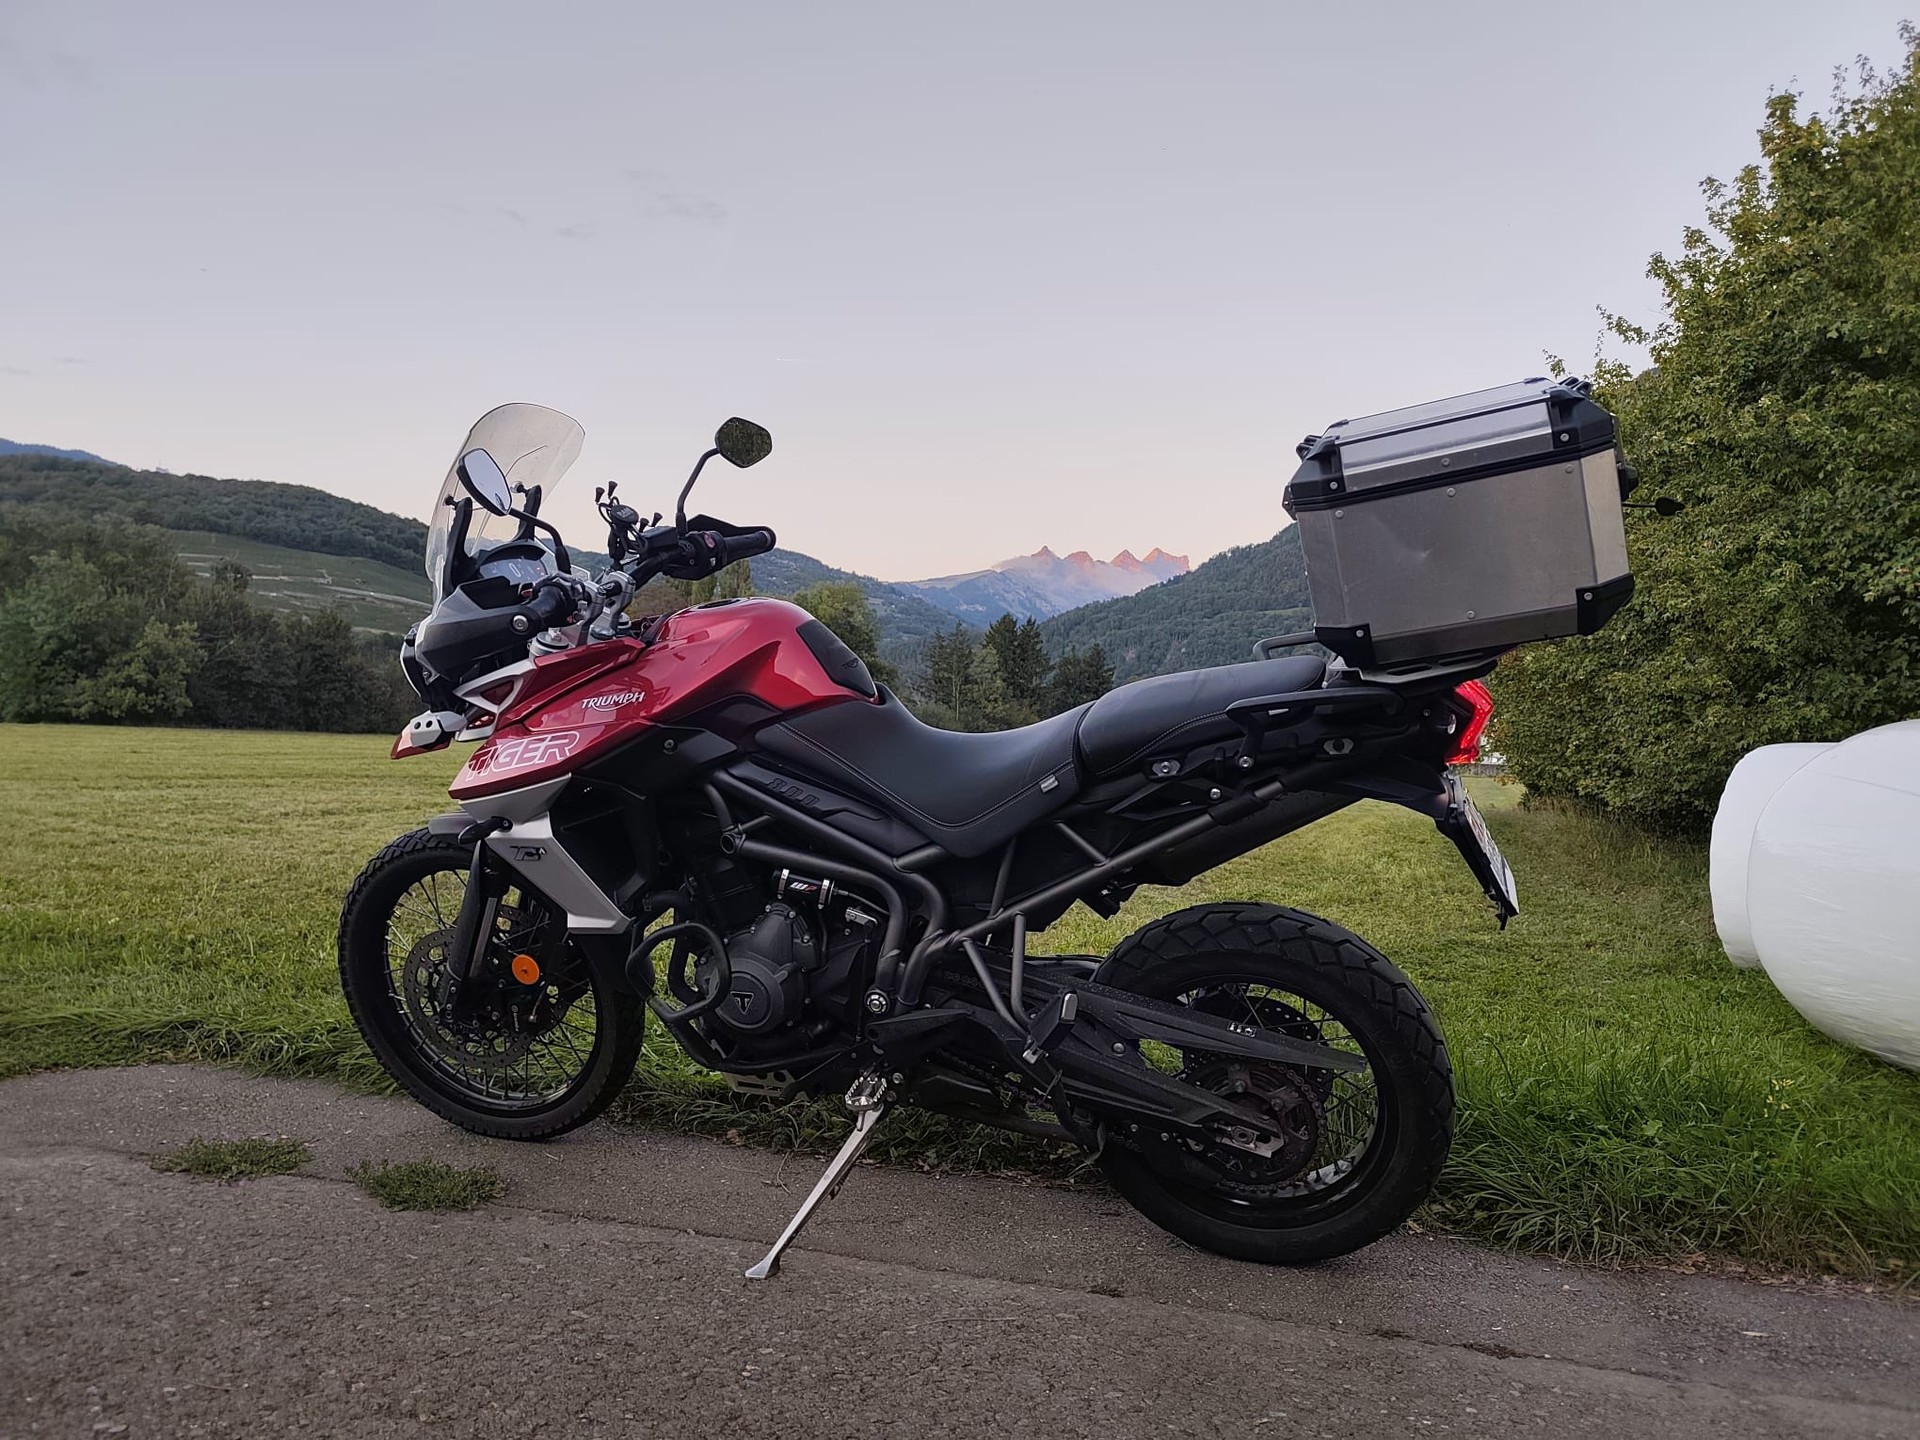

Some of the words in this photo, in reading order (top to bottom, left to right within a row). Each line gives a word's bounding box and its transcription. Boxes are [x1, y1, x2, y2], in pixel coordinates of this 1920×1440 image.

[581, 691, 646, 711] TRIUMPH
[466, 731, 580, 781] TIGER
[767, 777, 821, 807] 800
